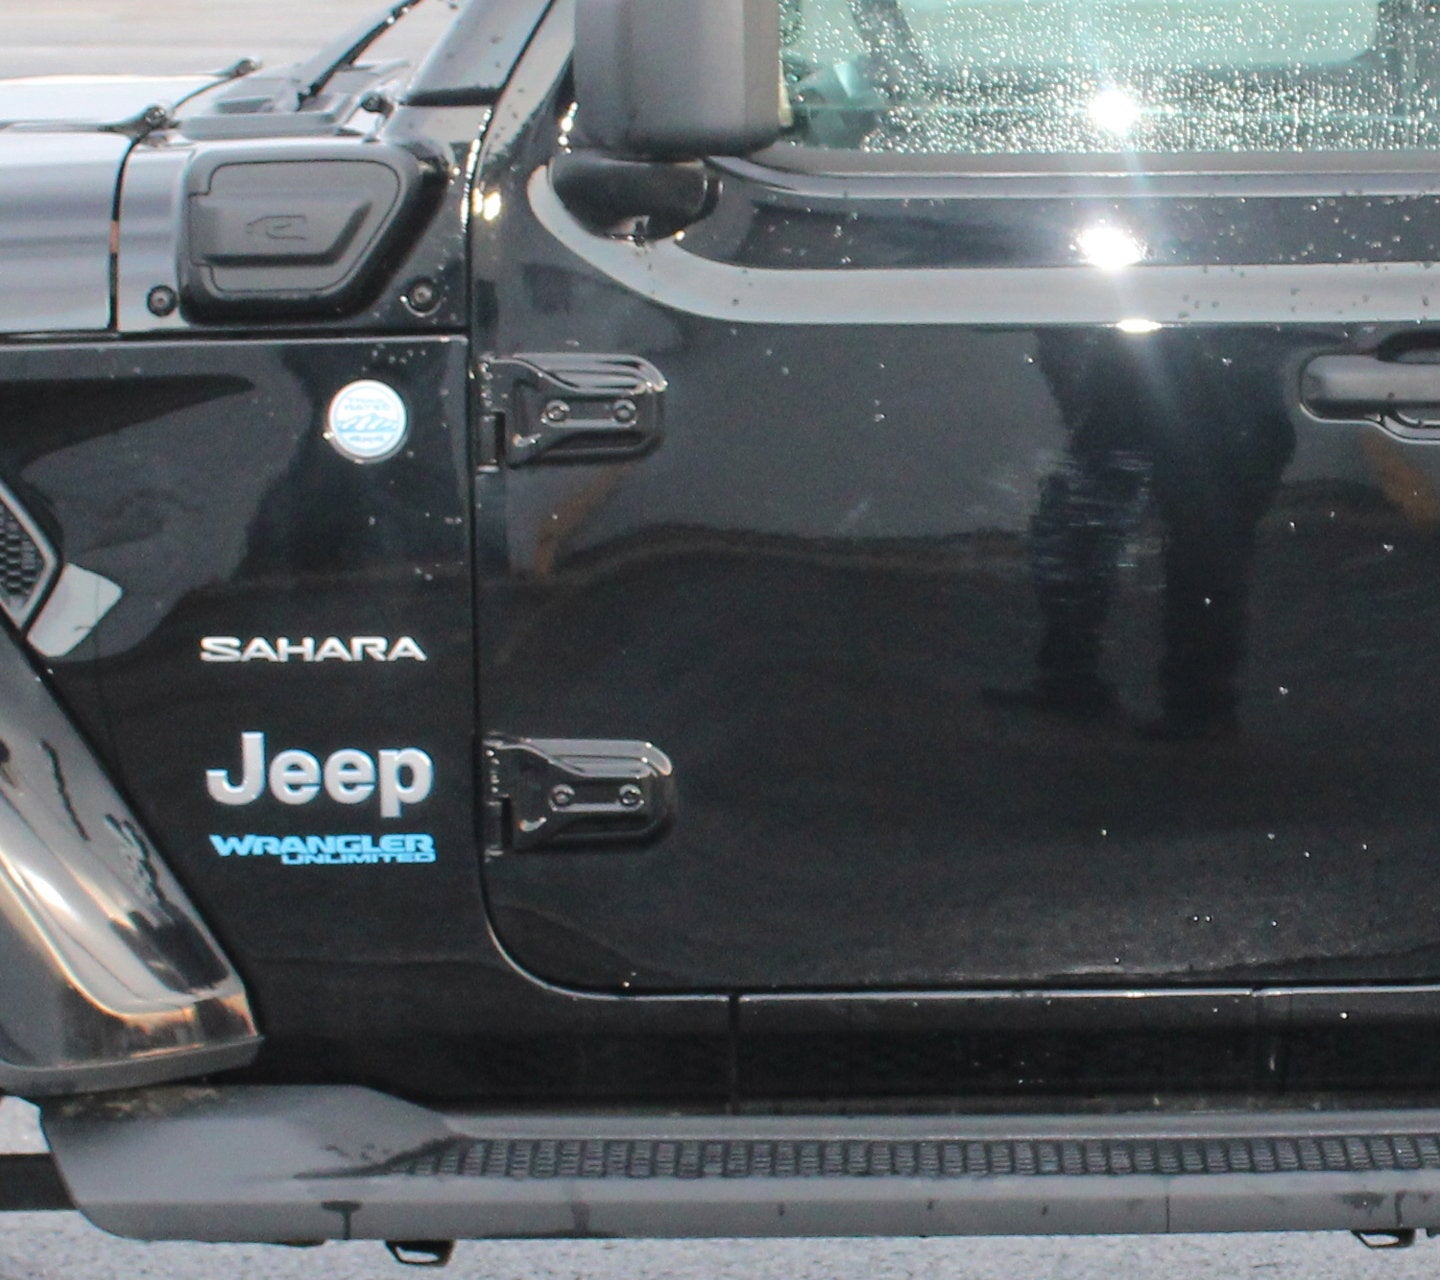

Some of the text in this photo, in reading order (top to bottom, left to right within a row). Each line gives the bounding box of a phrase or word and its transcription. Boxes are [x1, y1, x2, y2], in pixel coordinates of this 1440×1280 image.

[200, 636, 428, 662] SAHARA
[206, 731, 434, 818] Jeep
[209, 834, 435, 856] WRANGLER
[281, 851, 436, 865] UNLIMITED
